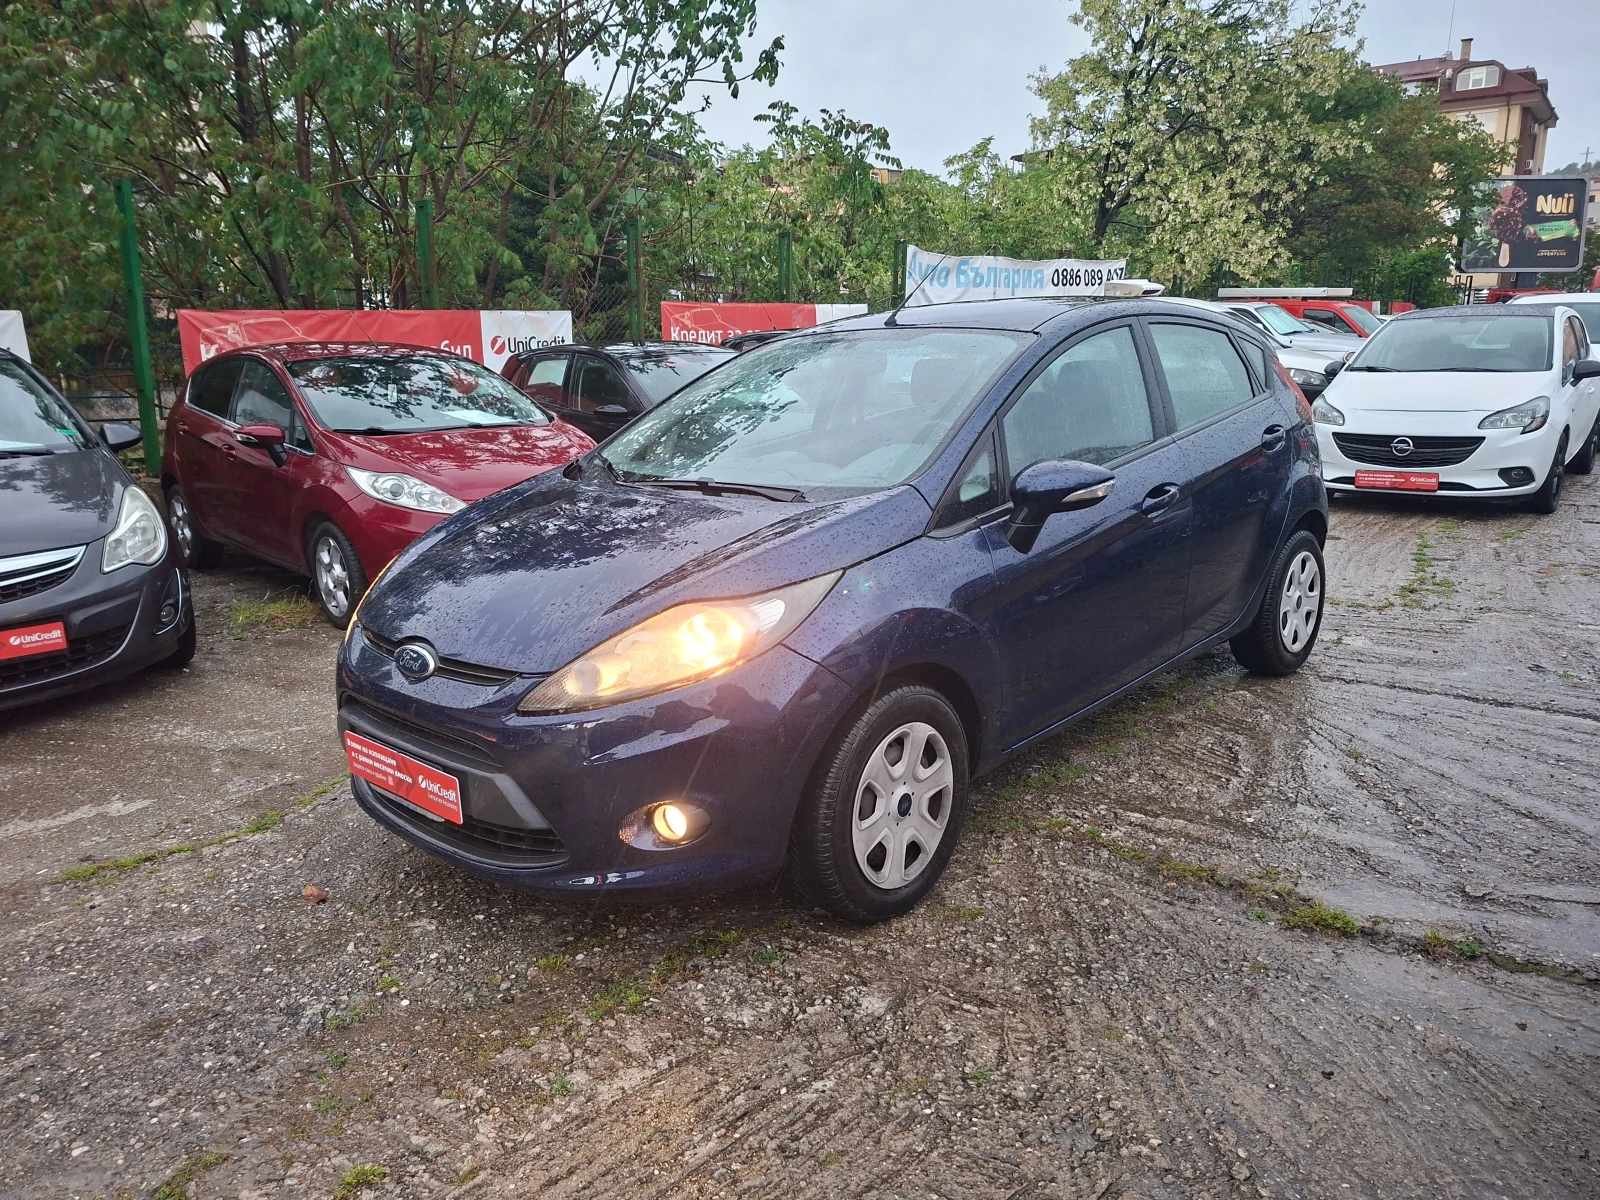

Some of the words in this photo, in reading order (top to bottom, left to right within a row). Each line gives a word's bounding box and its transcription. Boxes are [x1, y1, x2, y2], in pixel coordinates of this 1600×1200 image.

[955, 258, 1044, 296] България
[1051, 267, 1081, 287] 0886
[1084, 268, 1103, 287] 089
[671, 326, 723, 344] Кредит
[21, 629, 62, 643] UniCredit
[400, 650, 422, 671] Ford
[426, 779, 457, 803] UniCredit
